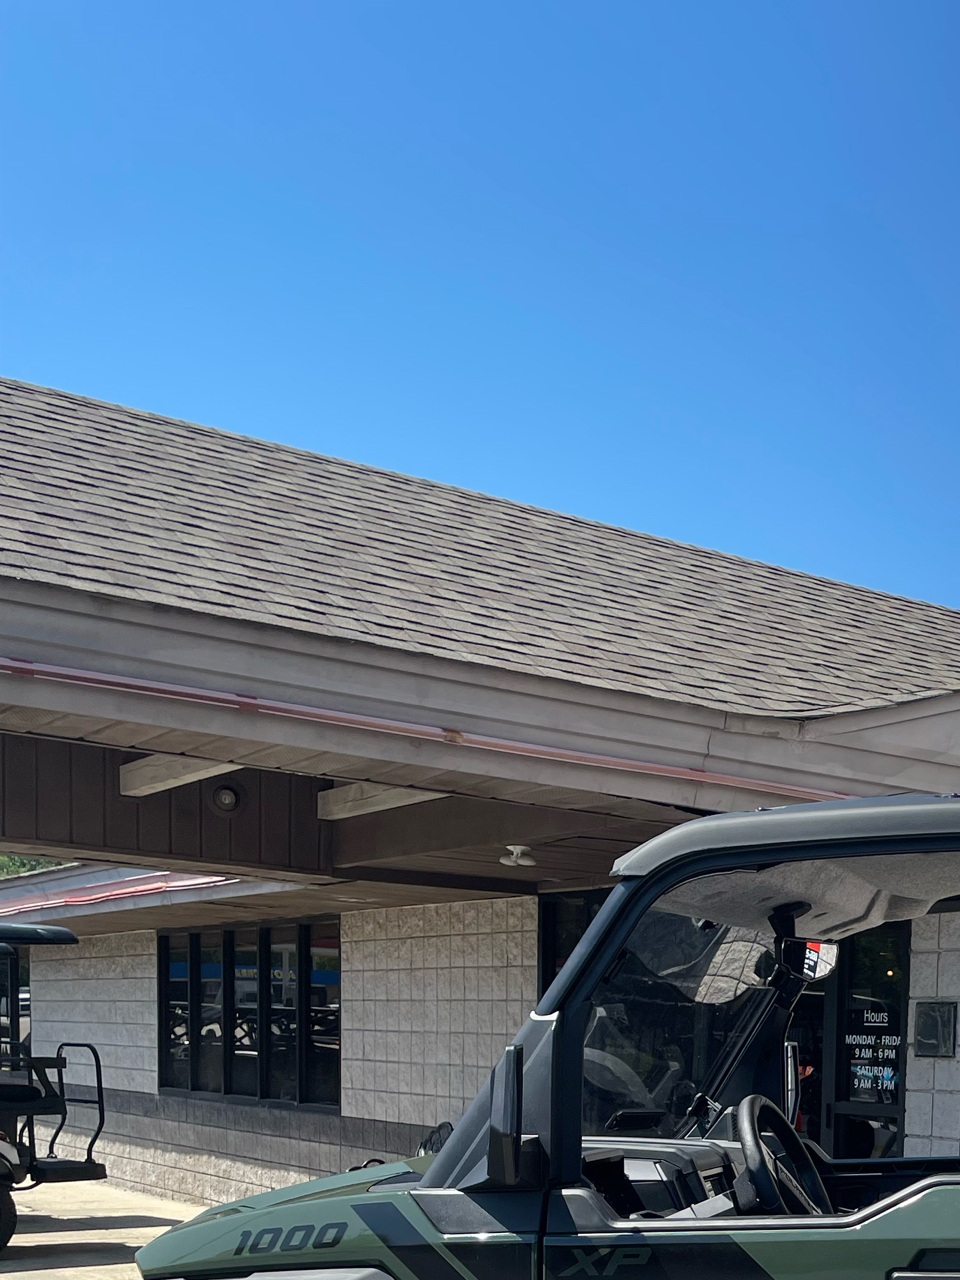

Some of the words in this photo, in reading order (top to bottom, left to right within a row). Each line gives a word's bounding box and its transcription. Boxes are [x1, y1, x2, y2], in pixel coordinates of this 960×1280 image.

[863, 1009, 888, 1022] Hours
[845, 1034, 876, 1045] MONDAY
[881, 1035, 901, 1046] FRIDA
[854, 1047, 860, 1058] 9
[861, 1048, 873, 1058] AM
[878, 1048, 883, 1059] 6
[884, 1049, 896, 1059] PM
[856, 1065, 893, 1077] SATURDAY
[854, 1079, 859, 1089] 9
[860, 1079, 872, 1090] AM
[877, 1080, 882, 1090] 3
[883, 1080, 895, 1090] PM
[233, 1221, 349, 1256] 1000
[557, 1247, 653, 1277] XP
